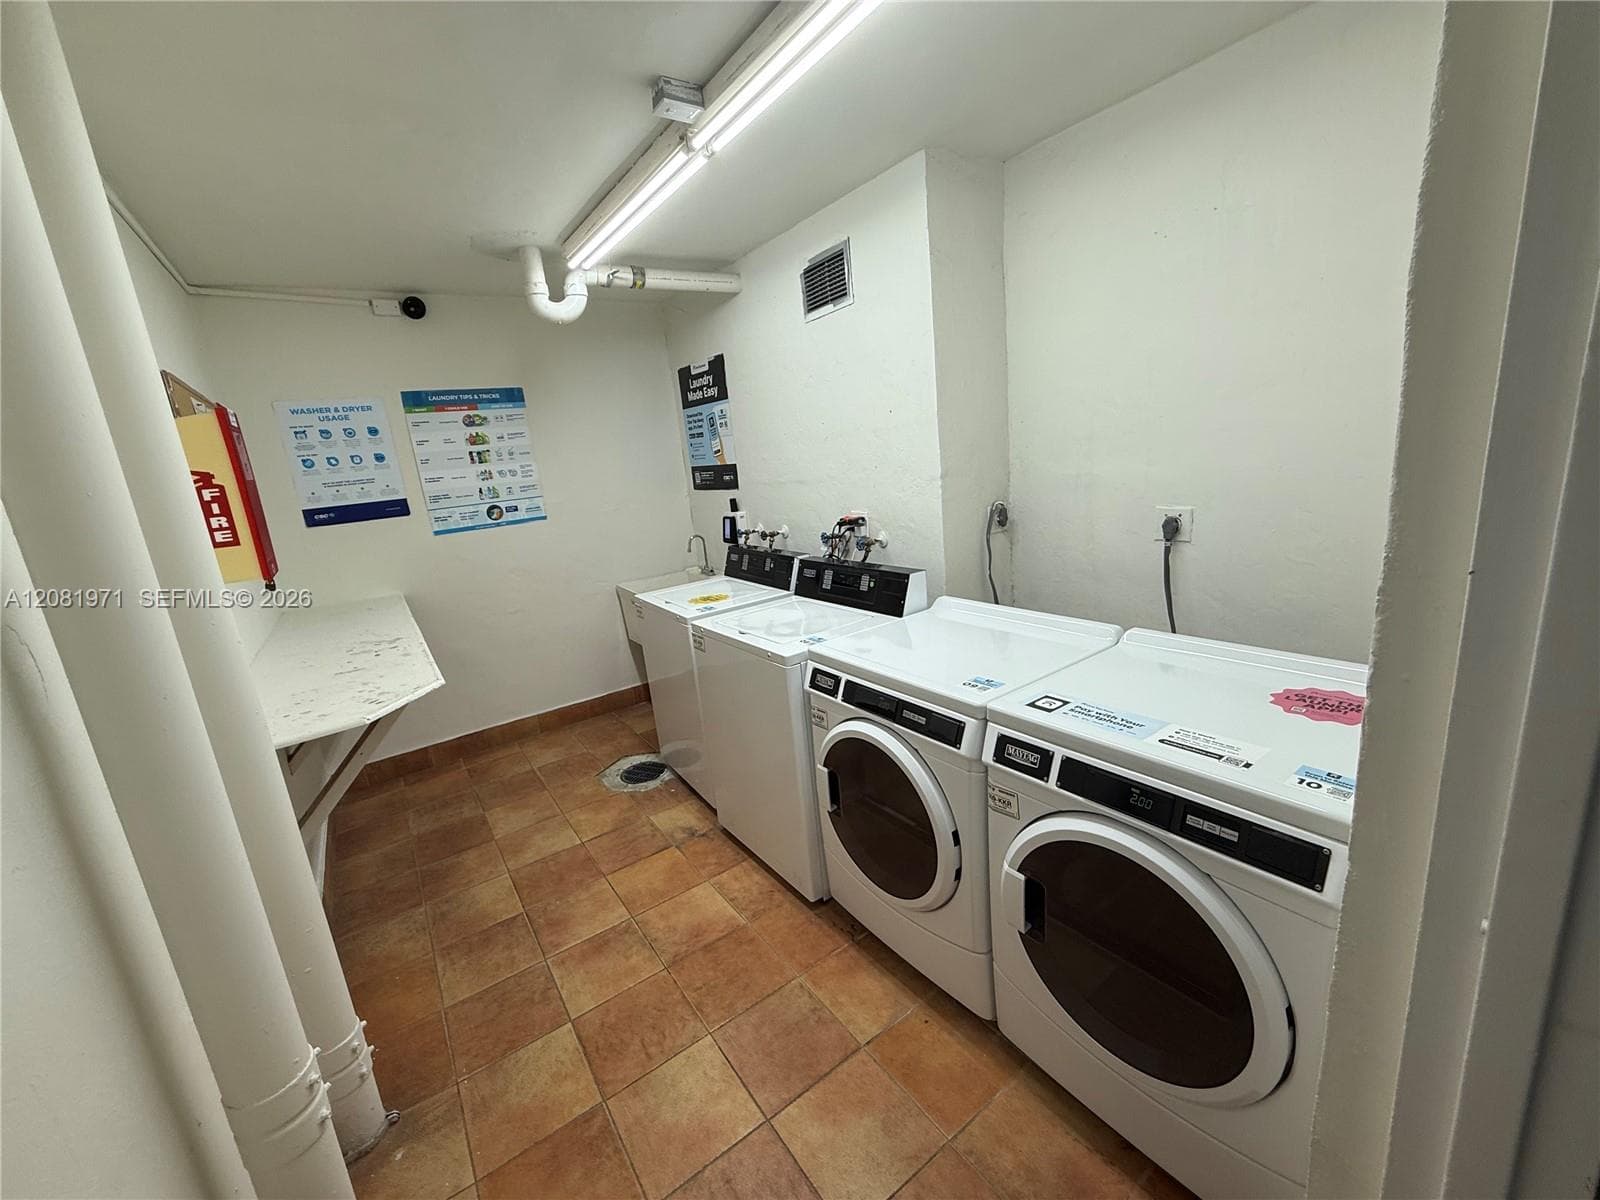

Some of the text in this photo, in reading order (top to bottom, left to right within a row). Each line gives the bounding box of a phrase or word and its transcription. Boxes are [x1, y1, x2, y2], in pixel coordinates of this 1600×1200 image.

[689, 374, 713, 389] Laundry
[687, 385, 718, 402] Made Easy
[289, 407, 331, 416] WASHER
[342, 405, 373, 413] DRYER
[318, 414, 350, 422] USAGE
[201, 488, 234, 543] FIRE
[1284, 696, 1362, 713] LAUNDR
[1294, 693, 1329, 702] GET
[1336, 700, 1364, 710] TH
[1068, 708, 1134, 730] Smartphone
[1074, 705, 1094, 713] Pay
[1095, 711, 1118, 720] with
[1120, 718, 1146, 728] Your
[1007, 746, 1038, 763] MAYTAG
[1297, 777, 1322, 789] 10
[1130, 794, 1153, 810] 2.00
